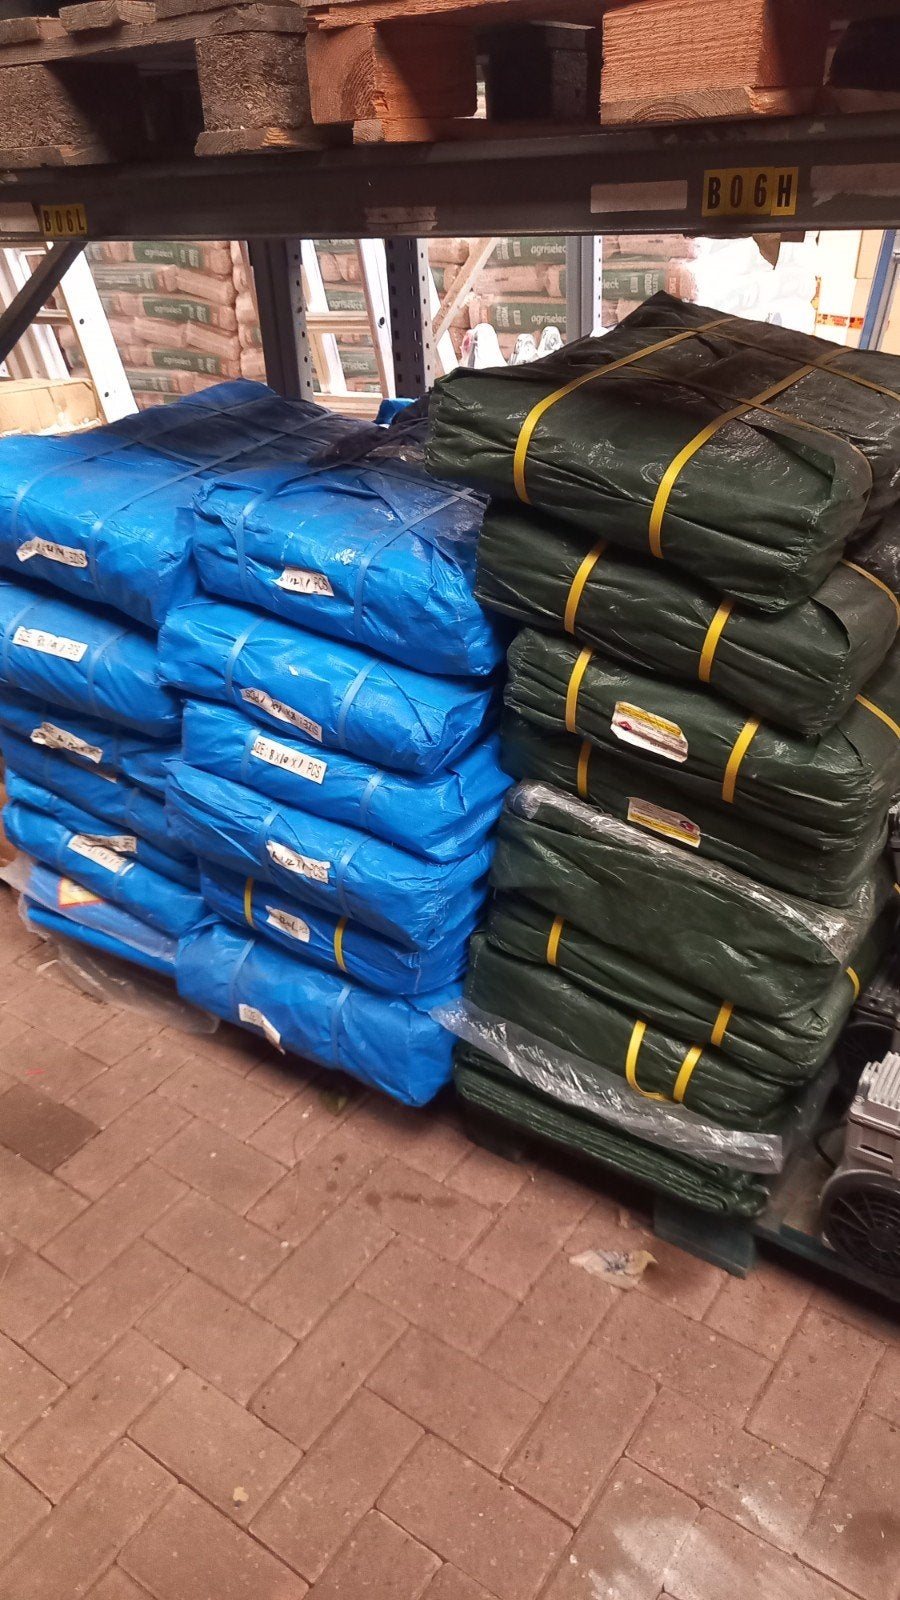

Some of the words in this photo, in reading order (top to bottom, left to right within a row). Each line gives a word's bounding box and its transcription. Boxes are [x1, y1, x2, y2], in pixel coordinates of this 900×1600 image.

[707, 173, 793, 210] B06H
[44, 208, 85, 233] B06L
[530, 243, 567, 256] agriselec
[530, 312, 567, 325] agriselec
[307, 762, 323, 779] PCS
